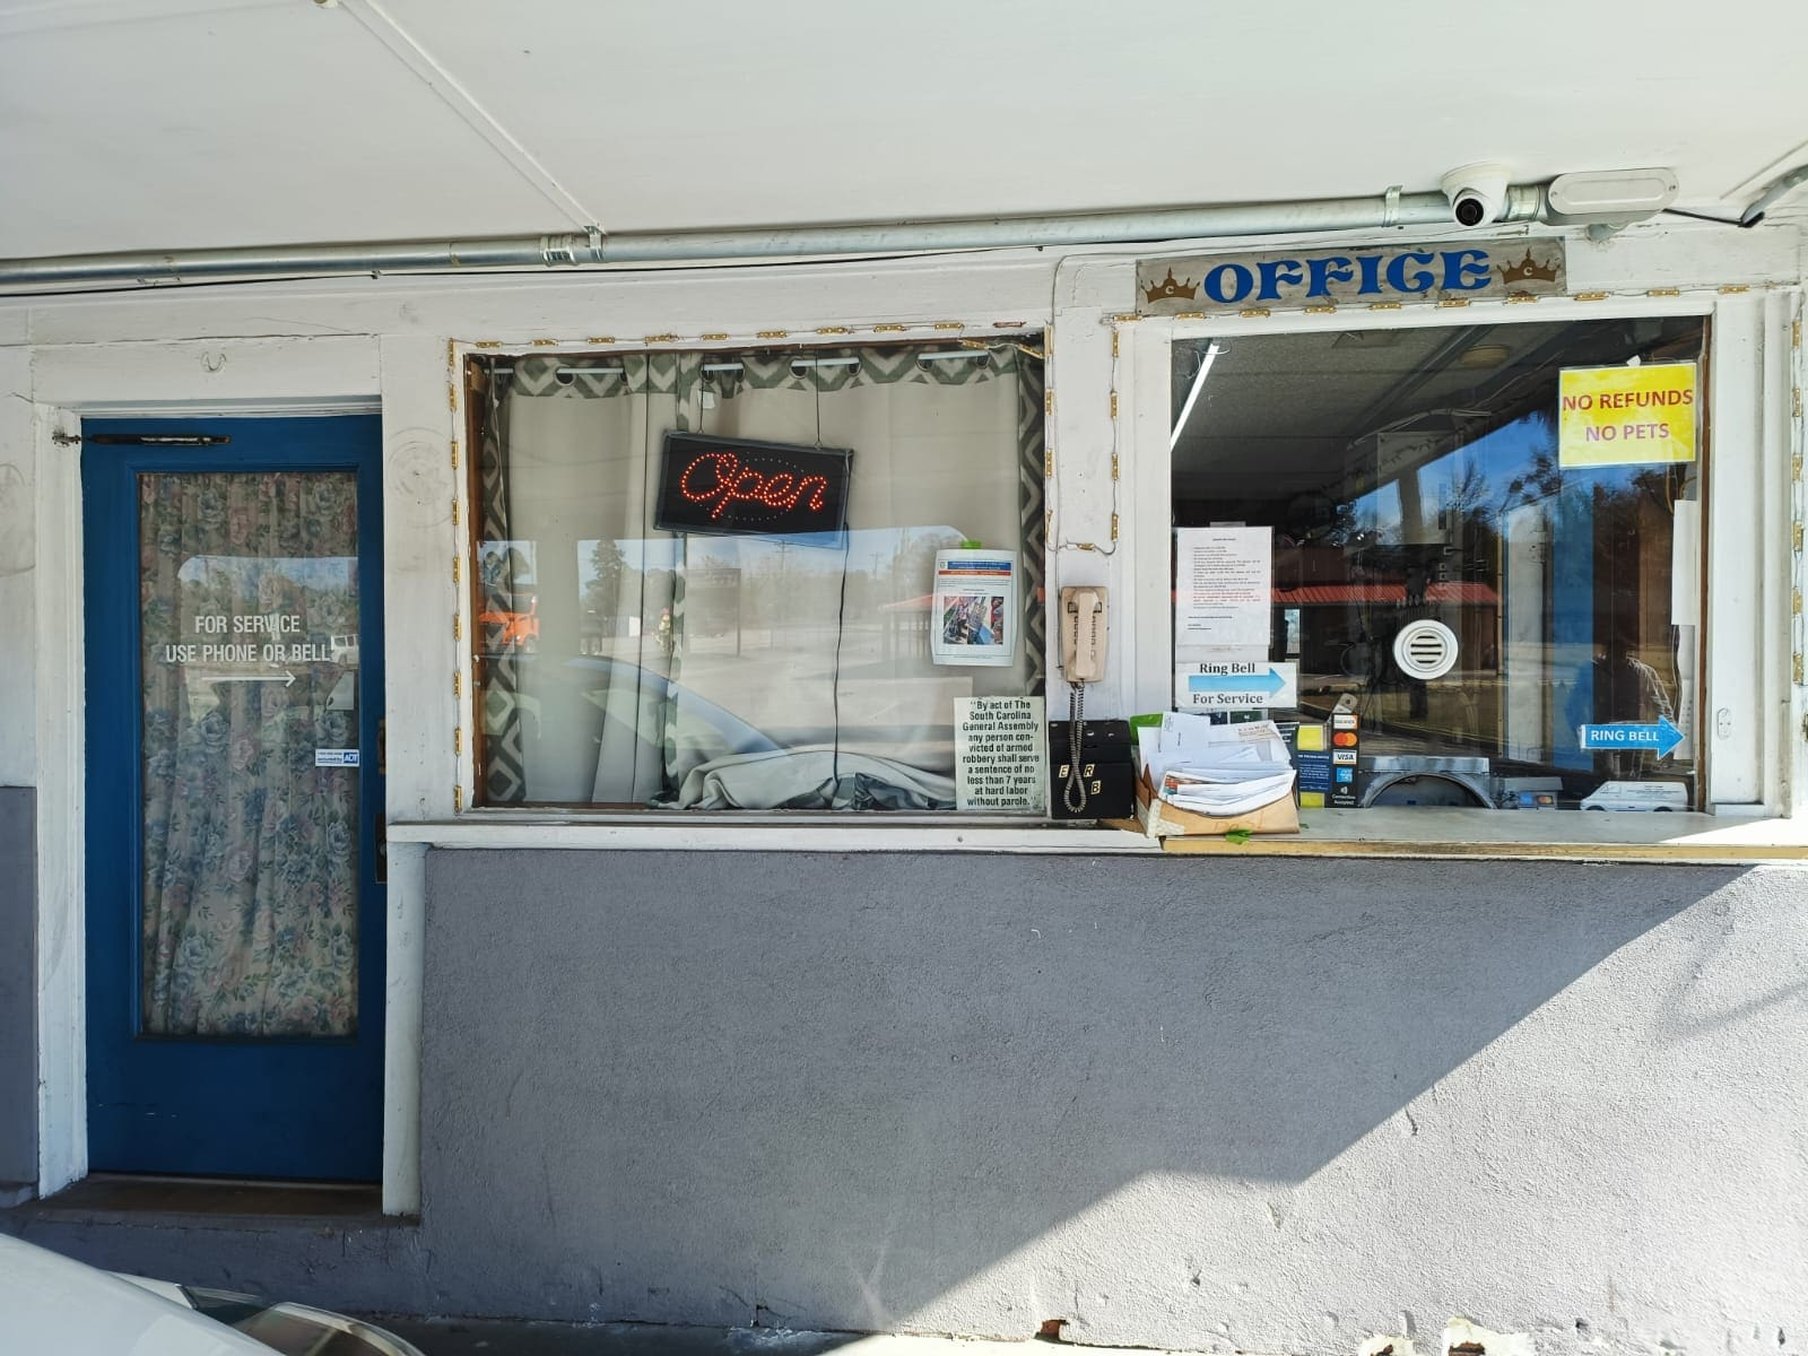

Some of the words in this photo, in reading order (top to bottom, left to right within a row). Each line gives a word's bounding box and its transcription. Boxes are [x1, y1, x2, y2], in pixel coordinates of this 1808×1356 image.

[1203, 248, 1492, 304] OFFICE
[1562, 395, 1593, 411] NO
[1600, 389, 1694, 409] REFUNDS
[1586, 425, 1617, 442] NO
[1623, 423, 1669, 440] PETS
[680, 452, 829, 519] Open
[195, 615, 227, 634] FOR
[233, 615, 300, 633] SERVICE
[166, 644, 197, 663] USE
[203, 644, 257, 662] PHONE
[263, 644, 285, 662] OR
[292, 644, 331, 662] BELL
[1199, 663, 1228, 676] Ring
[1231, 663, 1255, 673] Bell
[1193, 693, 1214, 704] For
[1216, 693, 1263, 704] Service
[989, 701, 1002, 709] act
[1004, 700, 1012, 709] of
[1014, 700, 1031, 709] The
[969, 711, 994, 720] South
[996, 711, 1031, 720] Carolina
[962, 722, 996, 731] General
[997, 721, 1039, 732] Assembly
[968, 734, 983, 743] any
[985, 734, 1013, 743] person
[1591, 730, 1625, 741] RING
[1629, 730, 1659, 742] BELL
[968, 743, 994, 752] victed
[996, 743, 1004, 752] of
[1006, 743, 1033, 752] armed
[962, 754, 995, 765] robbery
[997, 754, 1017, 763] shall
[1018, 755, 1040, 763] serve
[967, 766, 973, 774] a
[974, 765, 1012, 774] sentence
[1013, 765, 1022, 773] of
[1024, 765, 1035, 773] no
[967, 776, 983, 784] less
[985, 776, 1004, 784] than
[1006, 776, 1011, 784] 7
[1013, 776, 1036, 785] years
[974, 787, 983, 795] at
[985, 786, 1004, 795] hard
[1006, 786, 1028, 795] labor
[967, 797, 999, 806] without
